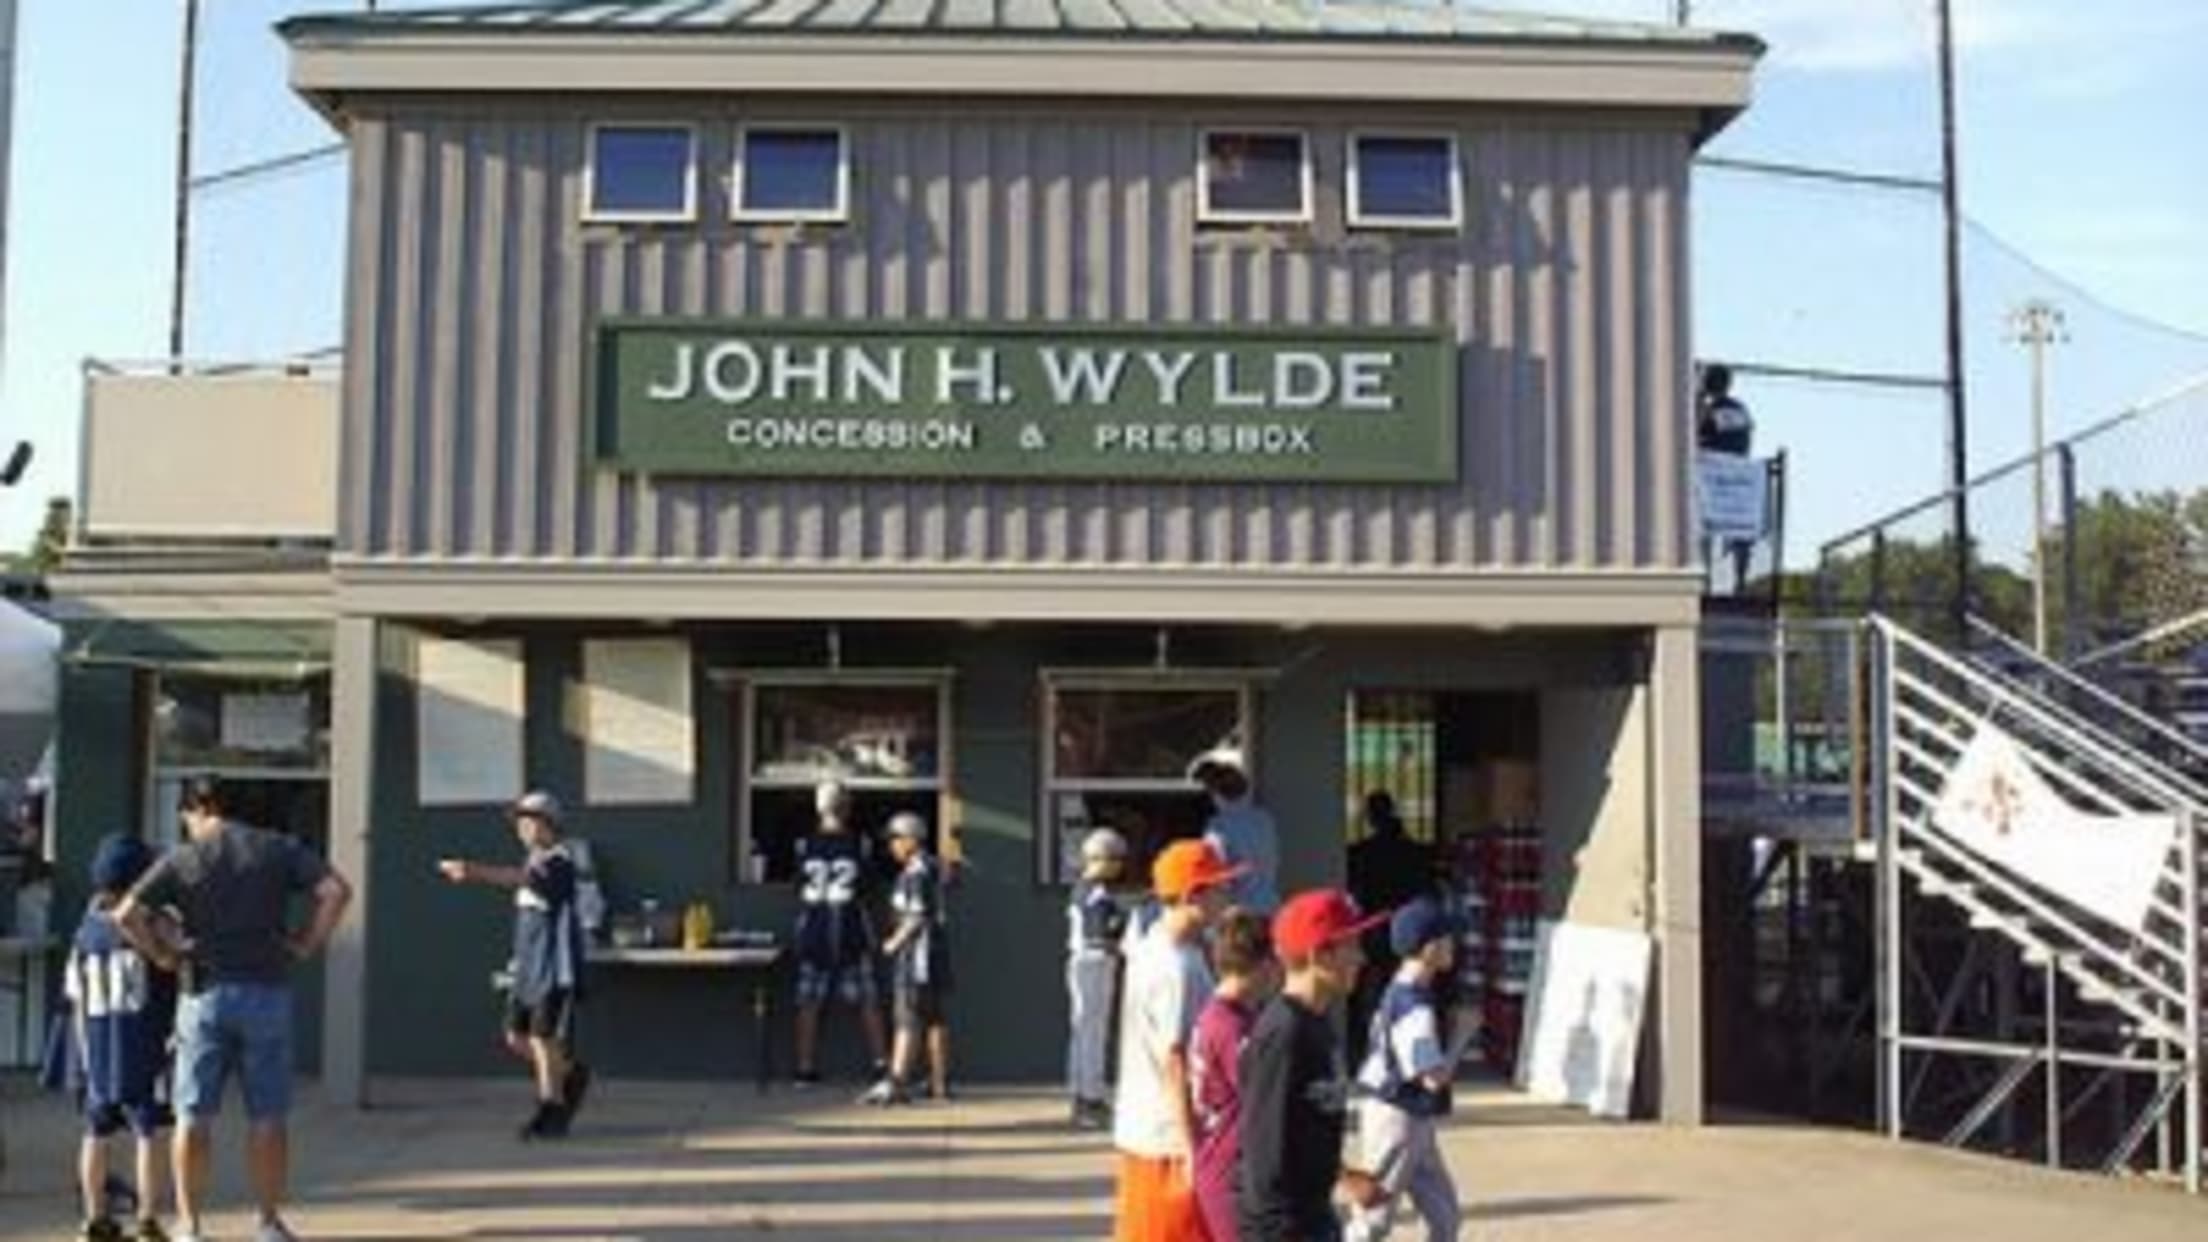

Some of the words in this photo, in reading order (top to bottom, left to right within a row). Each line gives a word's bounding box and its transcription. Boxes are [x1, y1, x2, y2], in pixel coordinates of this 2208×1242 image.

[648, 340, 902, 402] JOHN
[936, 346, 1013, 402] H.
[1039, 346, 1394, 408] WYLDE
[727, 417, 974, 449] CONCESSION
[1019, 423, 1045, 449] &
[1095, 423, 1313, 453] PRESSBOX
[802, 858, 857, 904] 32
